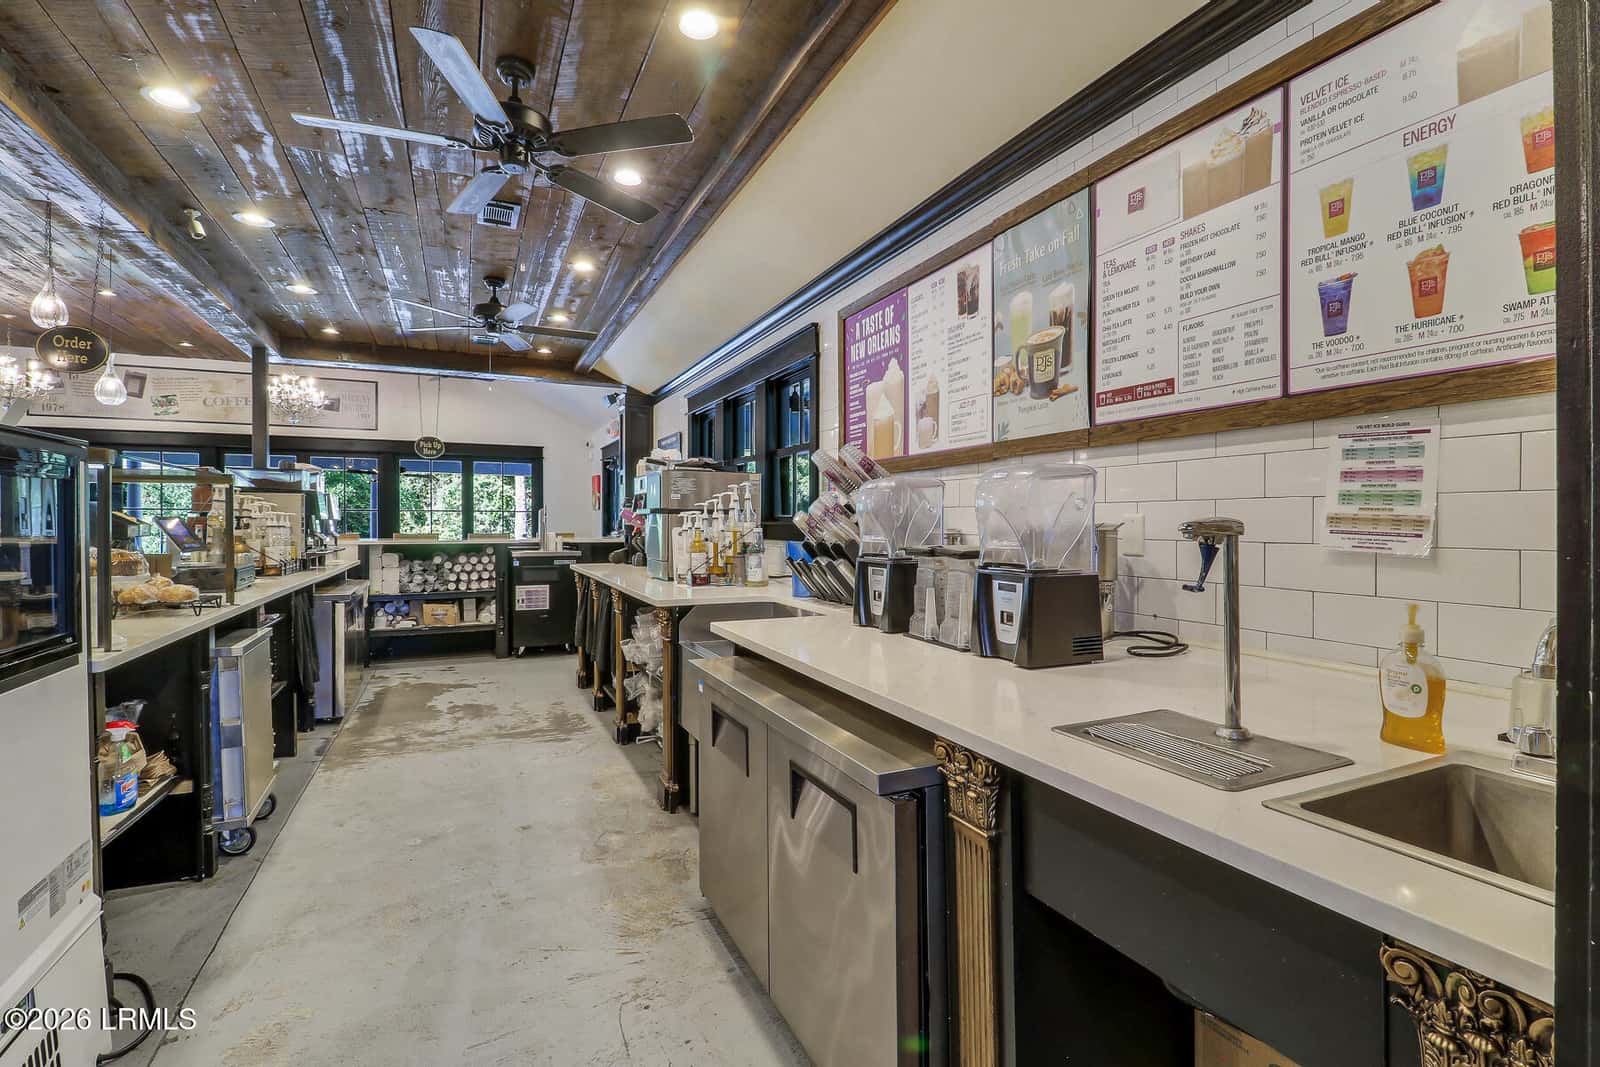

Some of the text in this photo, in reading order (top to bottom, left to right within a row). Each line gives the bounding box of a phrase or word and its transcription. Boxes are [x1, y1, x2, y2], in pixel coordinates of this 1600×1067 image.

[1300, 73, 1350, 106] VELVET ICE
[1300, 110, 1326, 127] VANILLA
[1327, 105, 1337, 115] OR
[1338, 85, 1380, 110] CHOCOLATE
[1300, 130, 1327, 148] PROTEIN
[1327, 119, 1353, 136] VELVET
[1353, 112, 1366, 125] ICE
[1402, 113, 1457, 148] ENERGY
[1492, 198, 1510, 212] RED
[1530, 202, 1538, 212] M
[1398, 202, 1460, 229] BLUE COCONUT
[1179, 239, 1198, 251] FROZEN
[1199, 233, 1209, 244] HOT
[1209, 222, 1241, 240] CHOCOLATE
[1180, 222, 1206, 241] SHAKES
[1386, 230, 1402, 243] RED
[1023, 244, 1046, 265] Take
[1048, 238, 1060, 254] on
[1062, 223, 1080, 247] Fall
[1307, 231, 1366, 257] TROPICAL MANGO
[1203, 248, 1217, 260] CAKE
[1300, 258, 1313, 269] RED
[1103, 258, 1117, 270] TEAS
[1107, 258, 1137, 277] LEMONADE
[1179, 273, 1196, 284] COCOA
[1197, 260, 1237, 278] MARSHMALLOW
[1179, 290, 1193, 301] BUILD
[1194, 286, 1208, 296] YOUR
[1208, 282, 1221, 292] OWN
[1502, 298, 1537, 313] SWAMP
[1530, 310, 1539, 319] M
[855, 304, 894, 341] A TASTE OF
[1182, 320, 1205, 332] FLAVORS
[1394, 314, 1457, 334] THE HURRICANE
[53, 334, 93, 350] Order
[850, 340, 866, 363] NEW
[867, 323, 901, 356] ORLEANS
[1311, 335, 1354, 351] THE VOODOO
[1418, 331, 1425, 340] M
[1506, 333, 1529, 341] women
[419, 440, 442, 450] Pick Up
